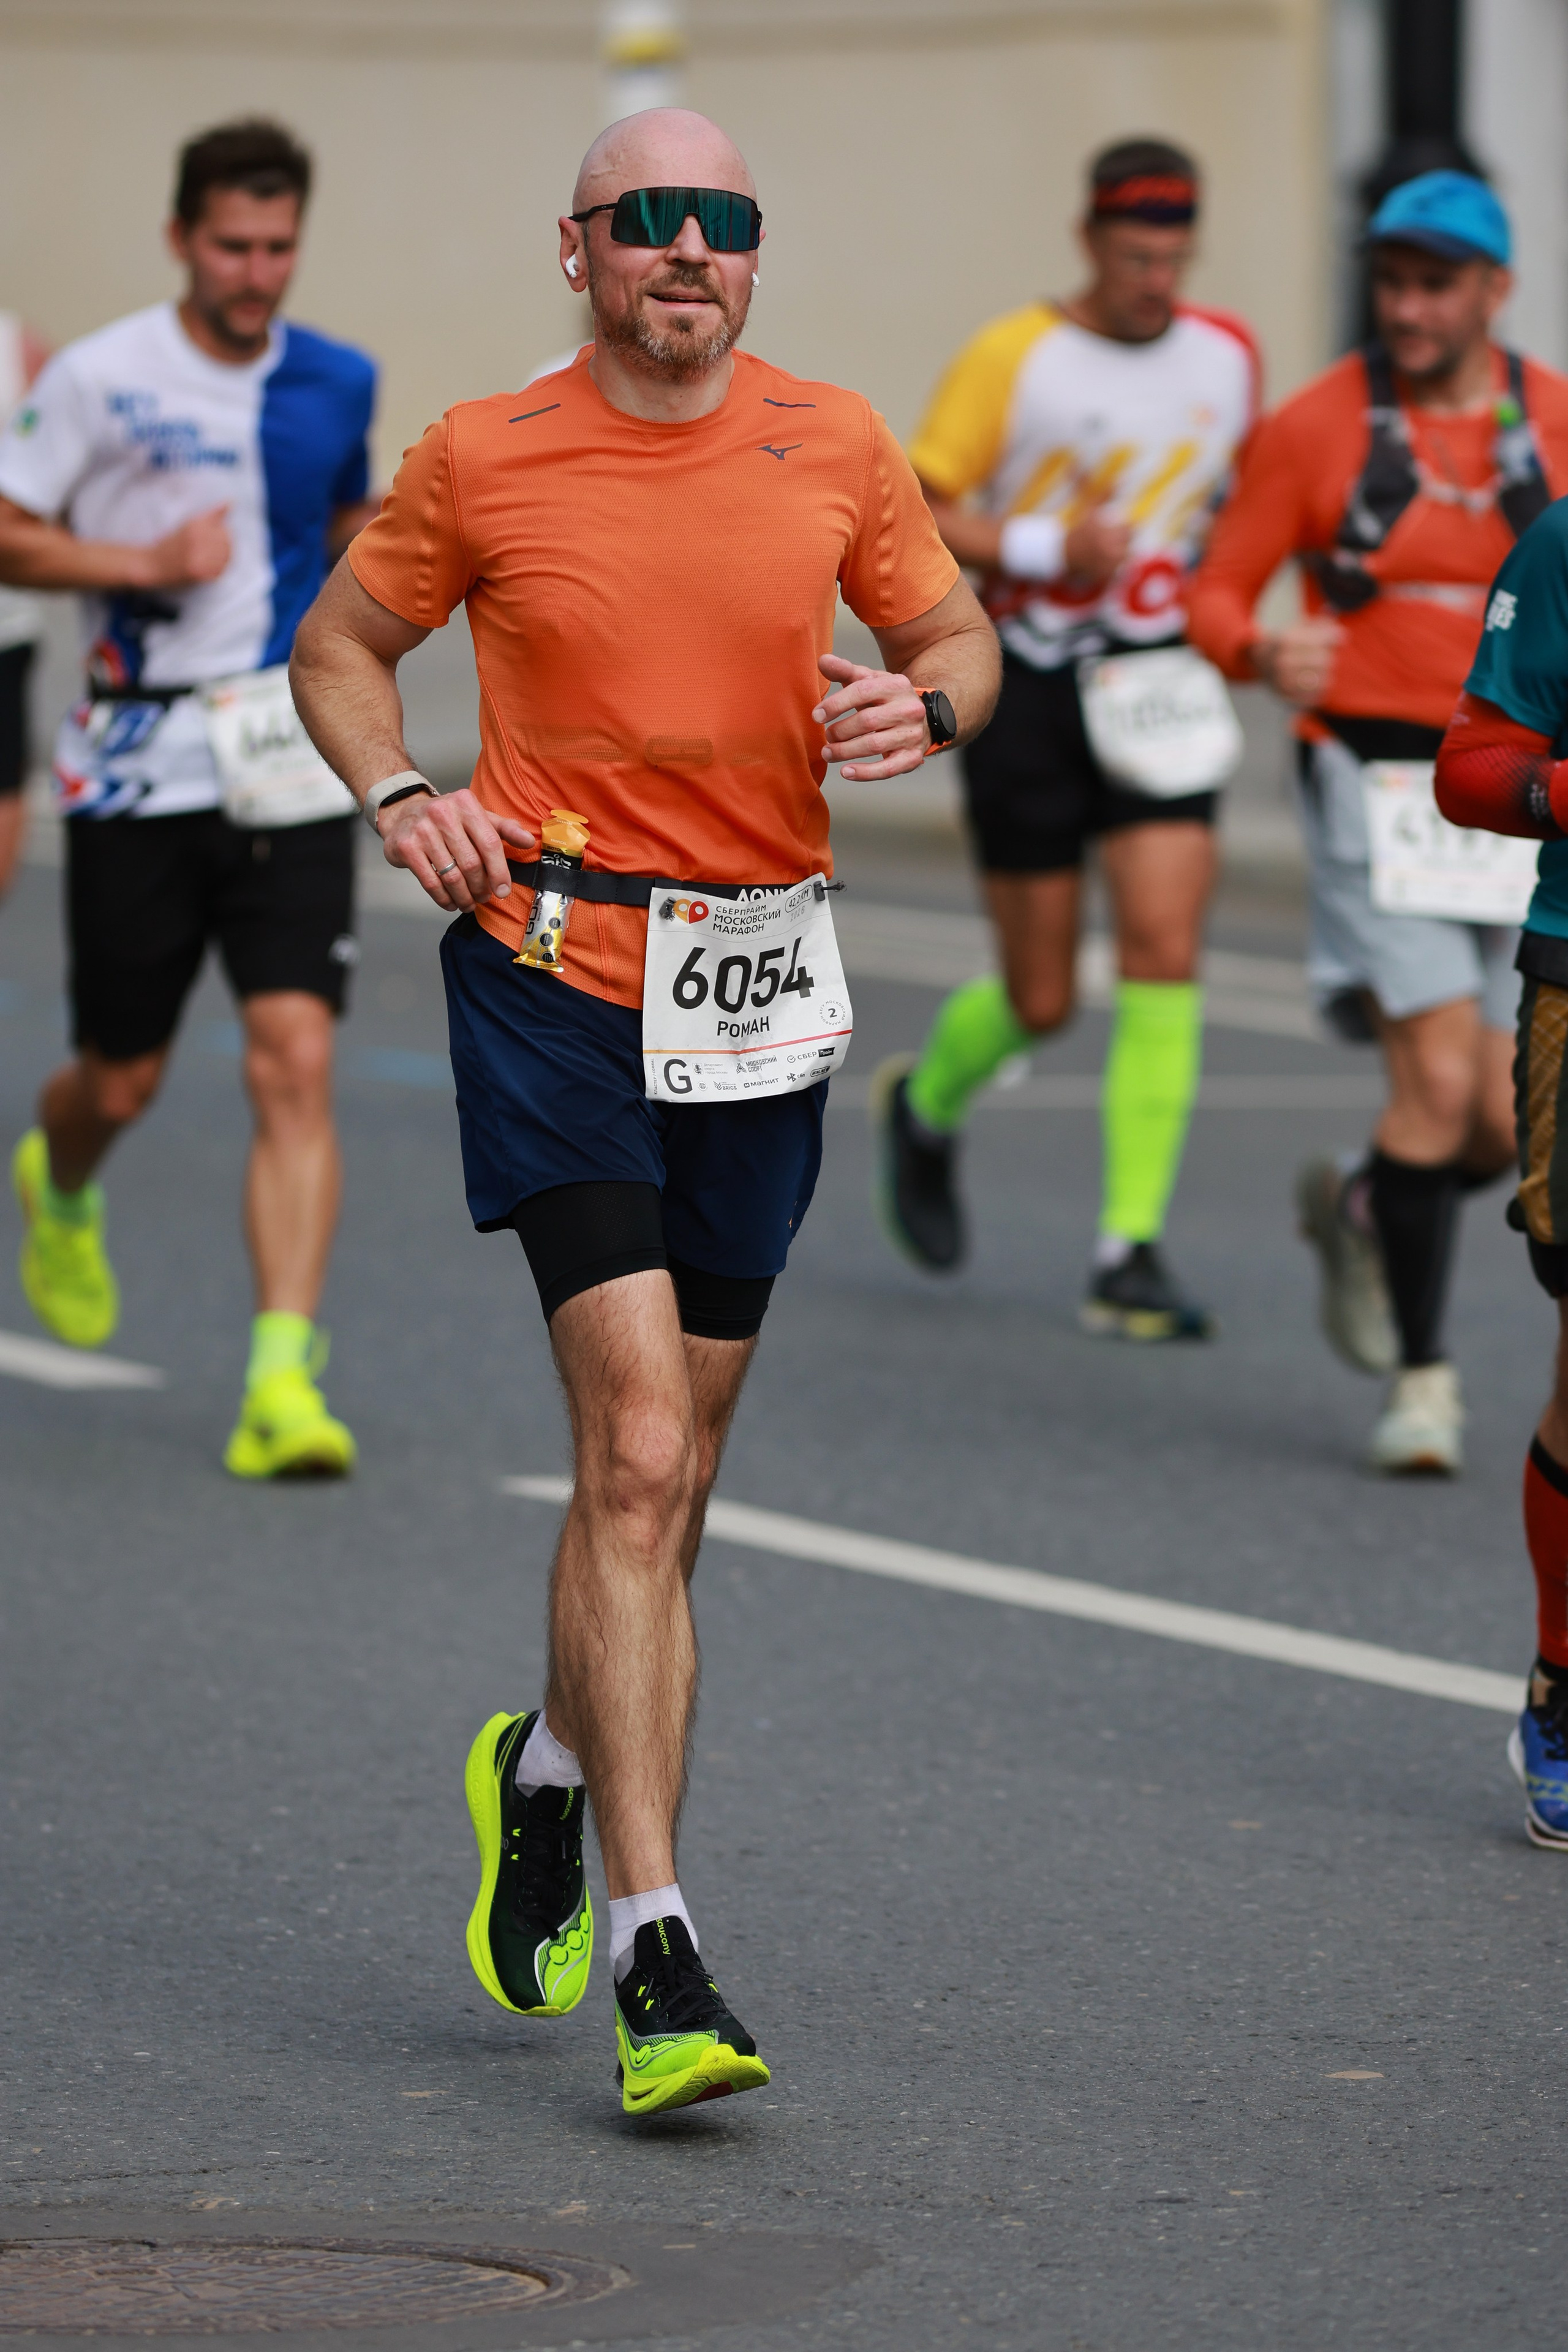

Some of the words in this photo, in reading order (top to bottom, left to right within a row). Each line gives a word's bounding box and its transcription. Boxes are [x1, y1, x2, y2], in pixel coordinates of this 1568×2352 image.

[714, 909, 781, 925] МОСКОВСКИЙ
[715, 905, 766, 916] СБЕРПРАЙМ
[712, 923, 764, 935] МАРАФОН
[673, 936, 815, 1014] 6054
[828, 1008, 837, 1018] 2
[717, 1016, 770, 1038] РОМАН
[745, 1055, 777, 1067] МОСКОВСКИЙ
[797, 1051, 817, 1060] СБЕР
[663, 1058, 693, 1095] G
[559, 1787, 575, 1821] saucony
[655, 1917, 671, 1955] saucony
